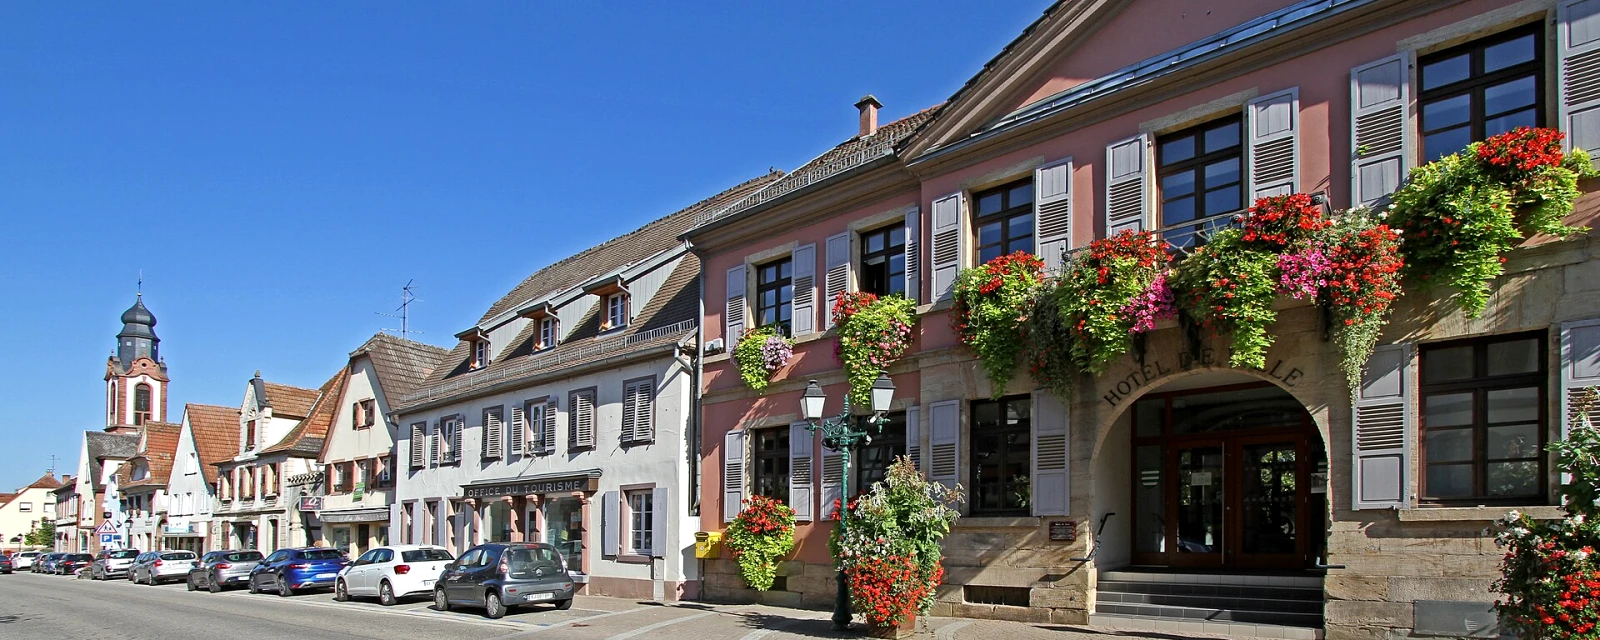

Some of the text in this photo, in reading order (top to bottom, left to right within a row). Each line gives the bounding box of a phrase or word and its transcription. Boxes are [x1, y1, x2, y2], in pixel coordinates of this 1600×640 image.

[468, 481, 580, 497] OFFICE DU TOURISME
